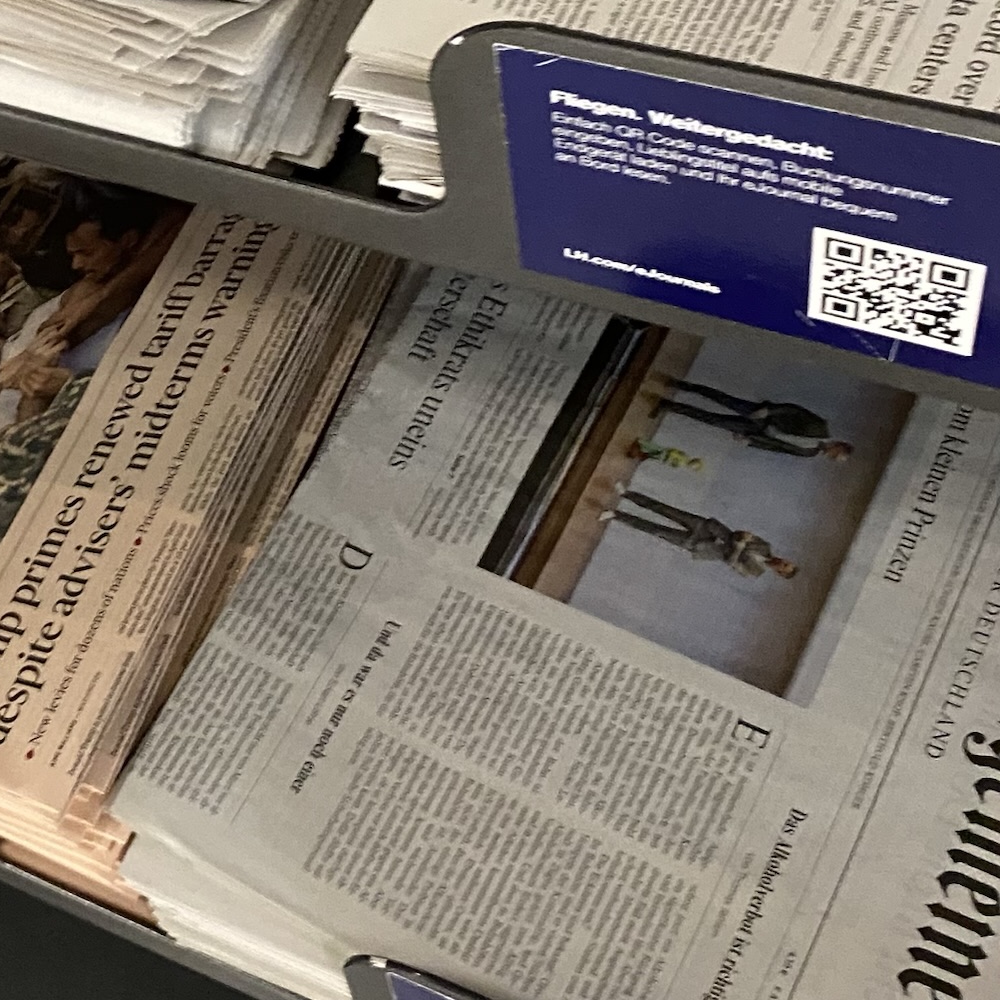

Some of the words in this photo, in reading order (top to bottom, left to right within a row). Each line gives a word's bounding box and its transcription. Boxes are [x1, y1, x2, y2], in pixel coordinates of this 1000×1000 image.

[846, 9, 865, 30] and
[876, 45, 892, 65] and
[908, 22, 960, 95] centers
[952, 60, 989, 104] over
[550, 88, 641, 124] Fliegen.
[551, 110, 611, 136] Einfach
[615, 123, 648, 143] QR
[652, 133, 695, 153] Code
[698, 144, 777, 171] scannen,
[781, 159, 953, 208] Buchungsnummer
[554, 150, 576, 165] an
[579, 154, 620, 174] Bord
[623, 164, 670, 185] lesen.
[553, 137, 627, 166] Endgerät
[630, 154, 677, 174] laden
[680, 164, 713, 182] und
[742, 179, 817, 206] eJournal
[821, 196, 897, 224] bequem
[782, 173, 843, 197] mobile
[408, 273, 472, 362] erschaft
[433, 295, 509, 392] Ethikrats
[121, 324, 218, 474] midterms
[201, 372, 232, 408] voters
[189, 406, 212, 428] for
[388, 395, 443, 471] uneins
[5, 492, 91, 610] primes
[74, 359, 155, 487] renewed
[140, 289, 193, 361] tariff
[170, 426, 203, 463] looms
[150, 460, 185, 497] shock
[918, 434, 970, 504] kleinen
[133, 496, 167, 535] Prices
[339, 542, 373, 570] D
[884, 506, 937, 583] Prinzen
[105, 545, 140, 593] nations
[99, 592, 115, 607] of
[74, 607, 109, 653] dozens
[381, 619, 402, 648] Und
[63, 653, 85, 675] for
[366, 647, 385, 661] da
[41, 674, 74, 713] levies
[353, 665, 372, 689] war
[342, 688, 357, 703] es
[26, 715, 53, 745] New
[329, 704, 349, 728] nur
[310, 729, 332, 759] noch
[731, 717, 773, 752] E
[290, 760, 316, 794] einer
[781, 807, 808, 836] Das
[741, 838, 792, 940] Alkoholverbot
[731, 940, 752, 960] ist
[700, 958, 738, 1000] richti
